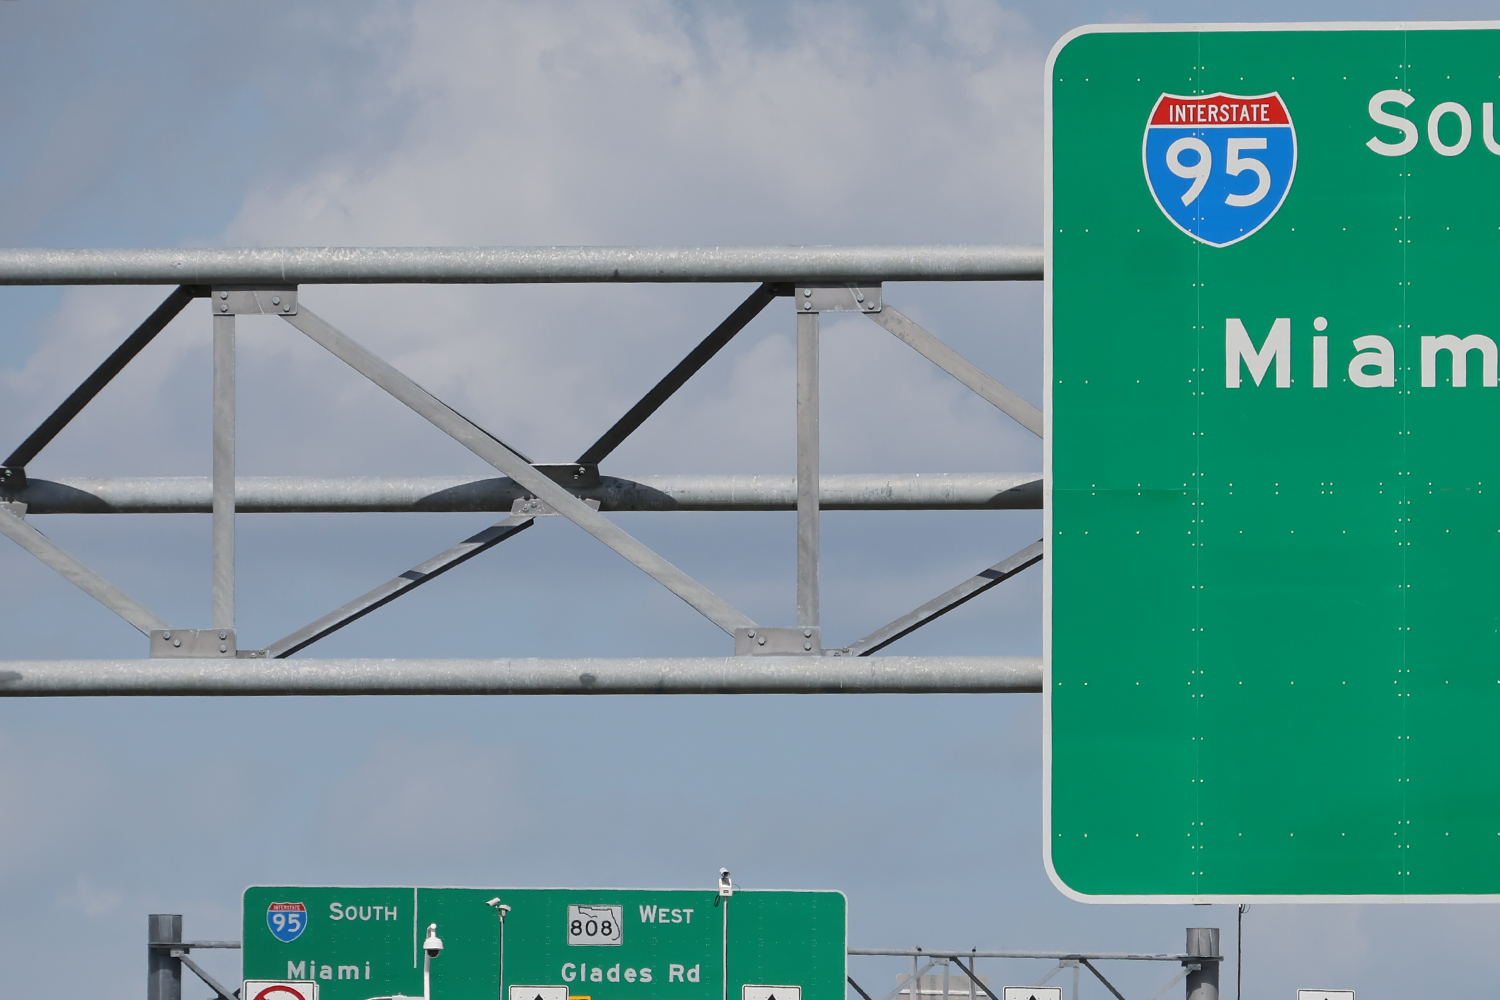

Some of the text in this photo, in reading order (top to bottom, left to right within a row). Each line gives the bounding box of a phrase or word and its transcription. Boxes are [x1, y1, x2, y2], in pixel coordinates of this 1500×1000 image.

[1168, 104, 1270, 122] INTERSTATE
[1166, 136, 1271, 207] 95
[329, 902, 397, 921] SOUTH
[639, 905, 694, 924] WEST
[272, 914, 301, 932] 95
[570, 920, 612, 936] 808
[287, 960, 370, 980] Miami
[561, 963, 700, 983] Glades Rd
